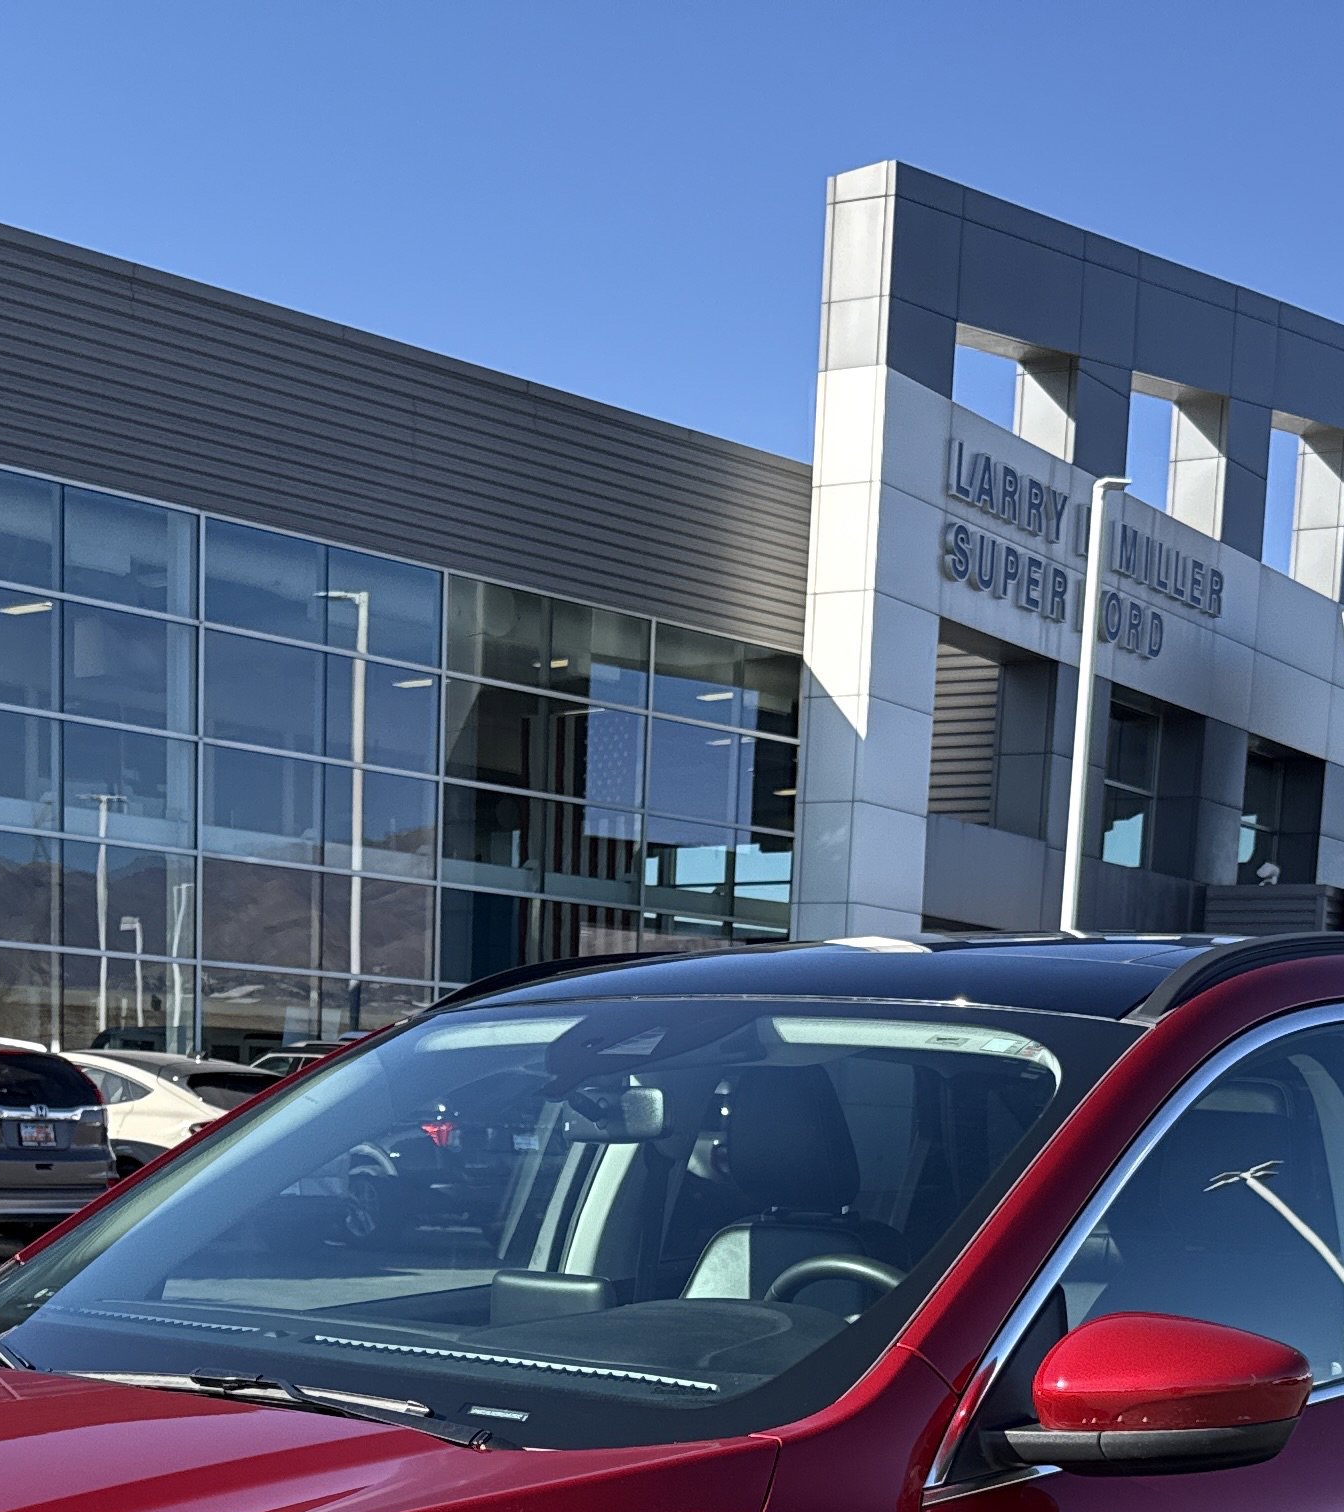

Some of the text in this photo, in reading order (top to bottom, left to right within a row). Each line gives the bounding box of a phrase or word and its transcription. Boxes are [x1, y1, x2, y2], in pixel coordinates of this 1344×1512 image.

[945, 522, 1068, 623] SUPER
[1078, 582, 1164, 659] ORD
[949, 440, 1069, 544] LARRY
[1113, 521, 1225, 618] MILLER
